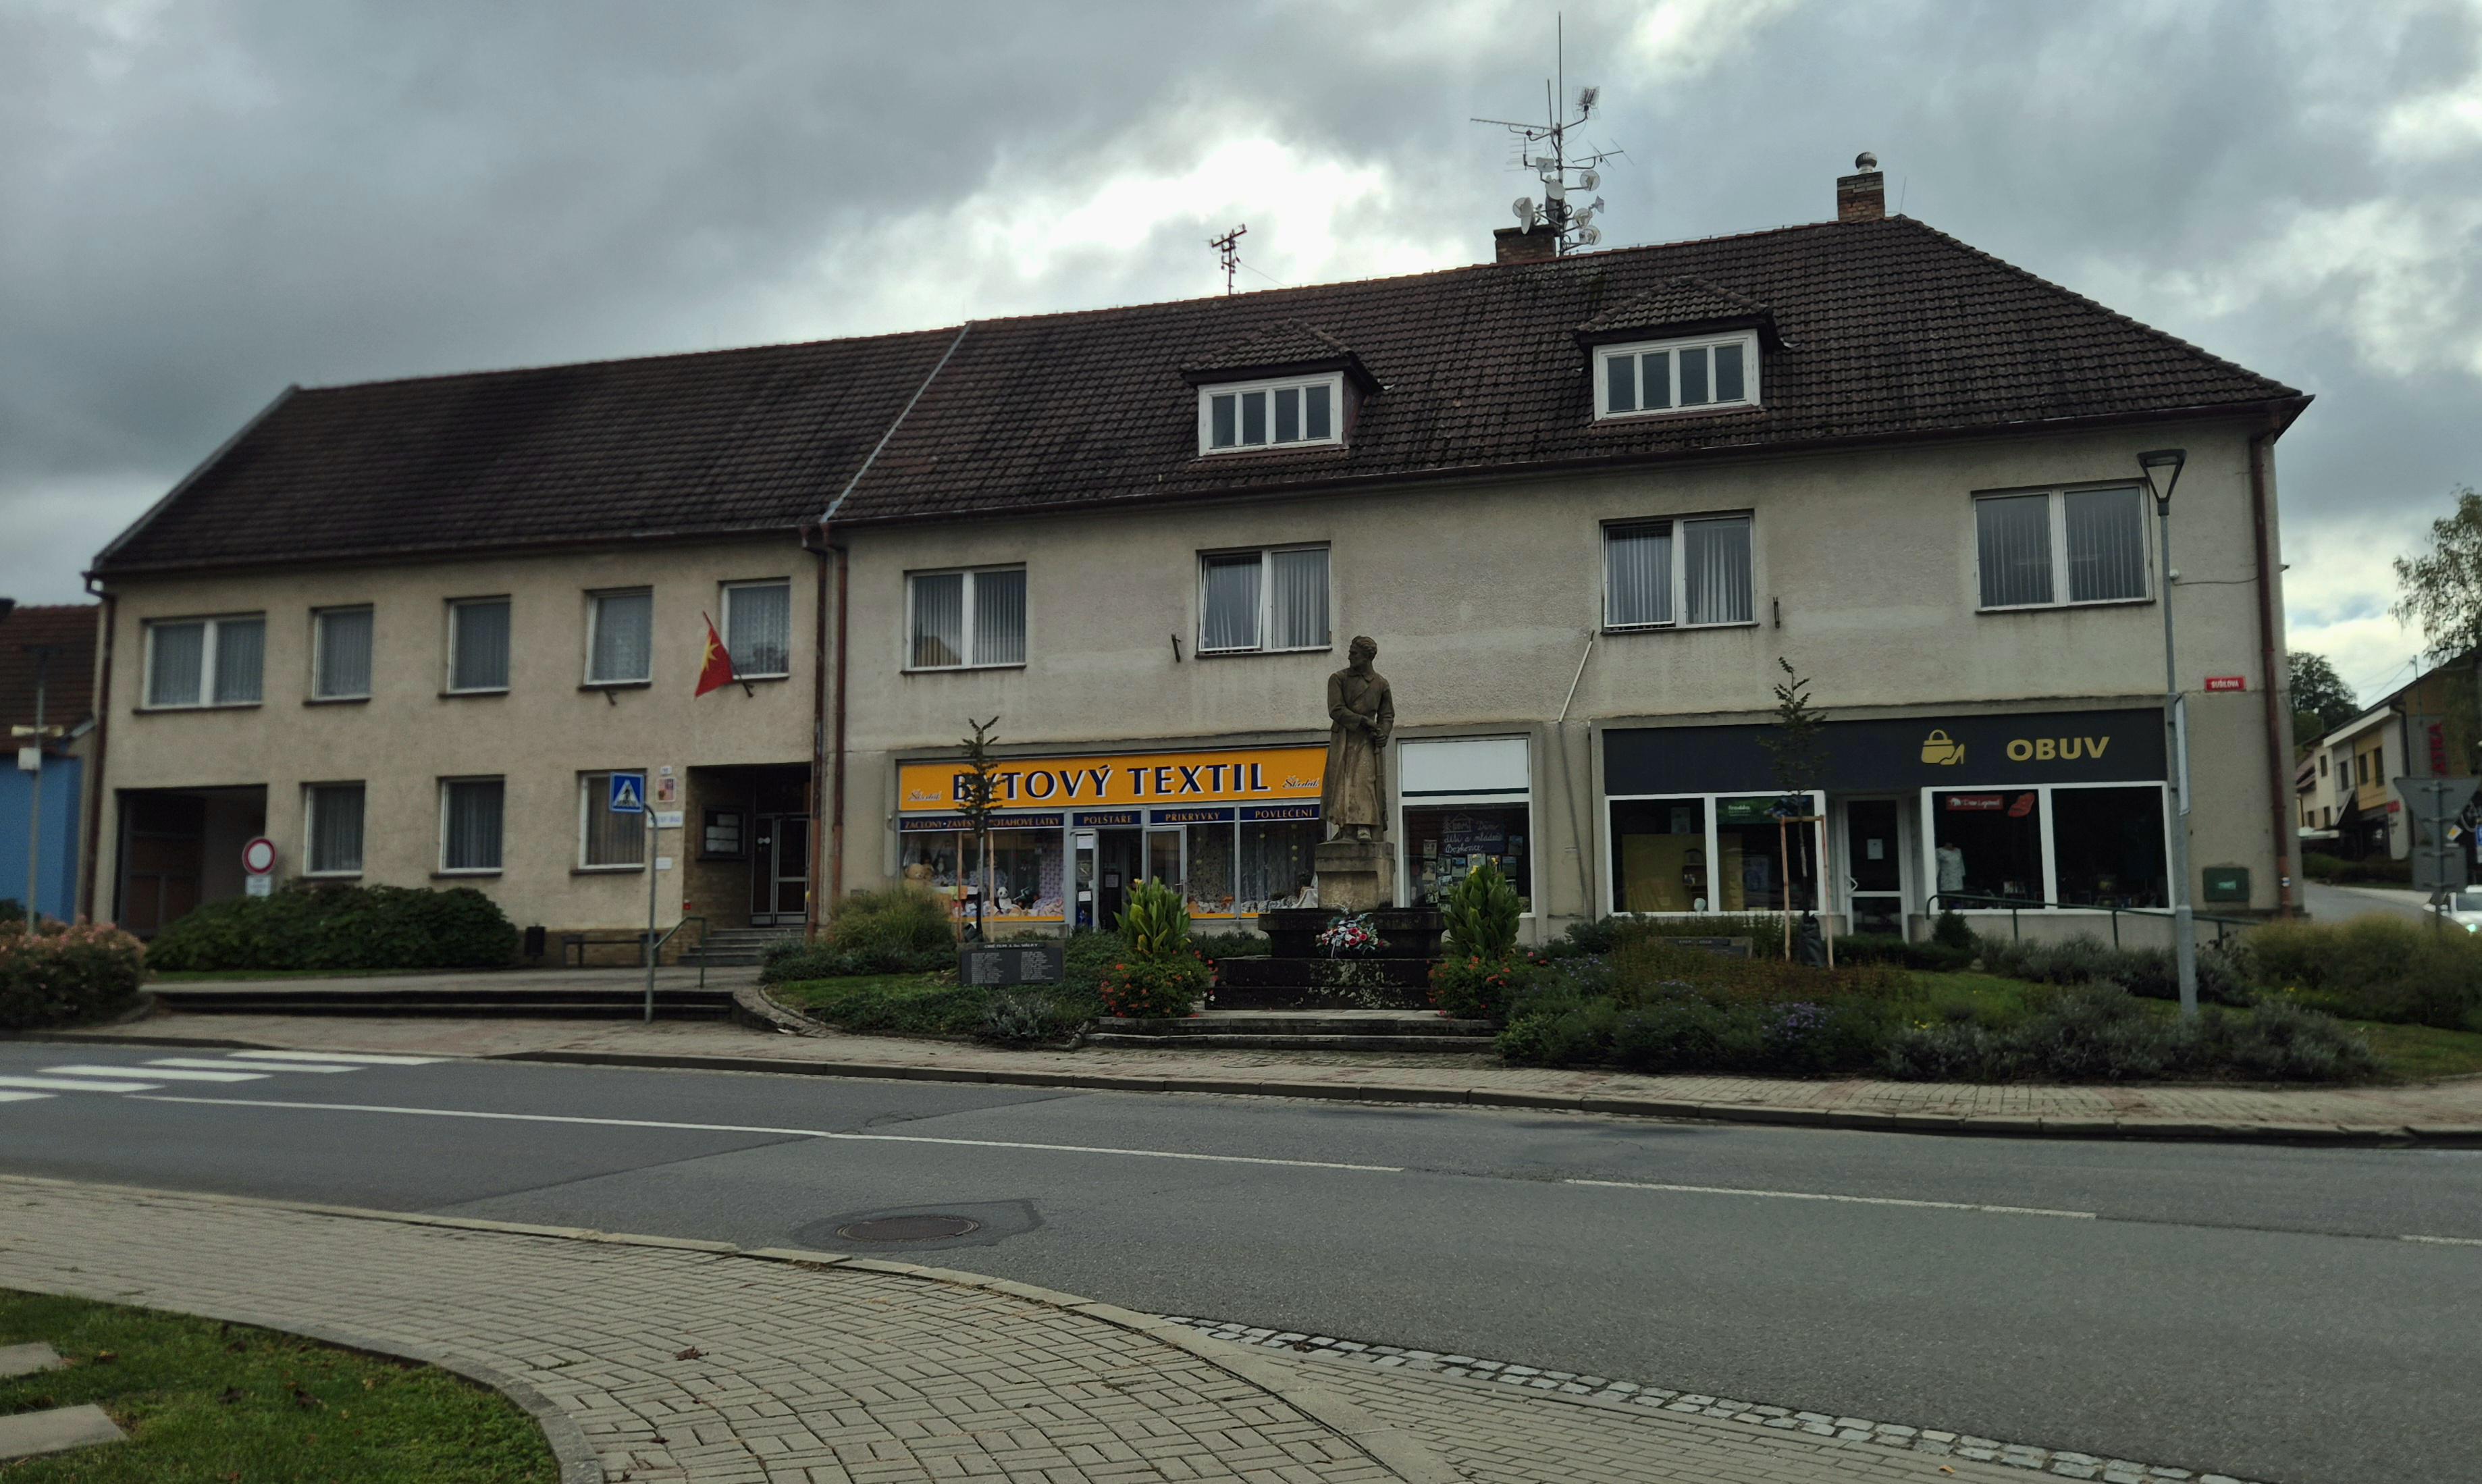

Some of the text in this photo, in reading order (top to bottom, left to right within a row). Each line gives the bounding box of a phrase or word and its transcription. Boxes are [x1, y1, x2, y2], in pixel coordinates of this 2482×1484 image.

[2006, 736, 2111, 762] OBUV
[1127, 763, 1271, 796] TEXTIL
[1165, 811, 1219, 821] PŘIKRÝVKY
[1255, 807, 1313, 818] POVLEČENÍ
